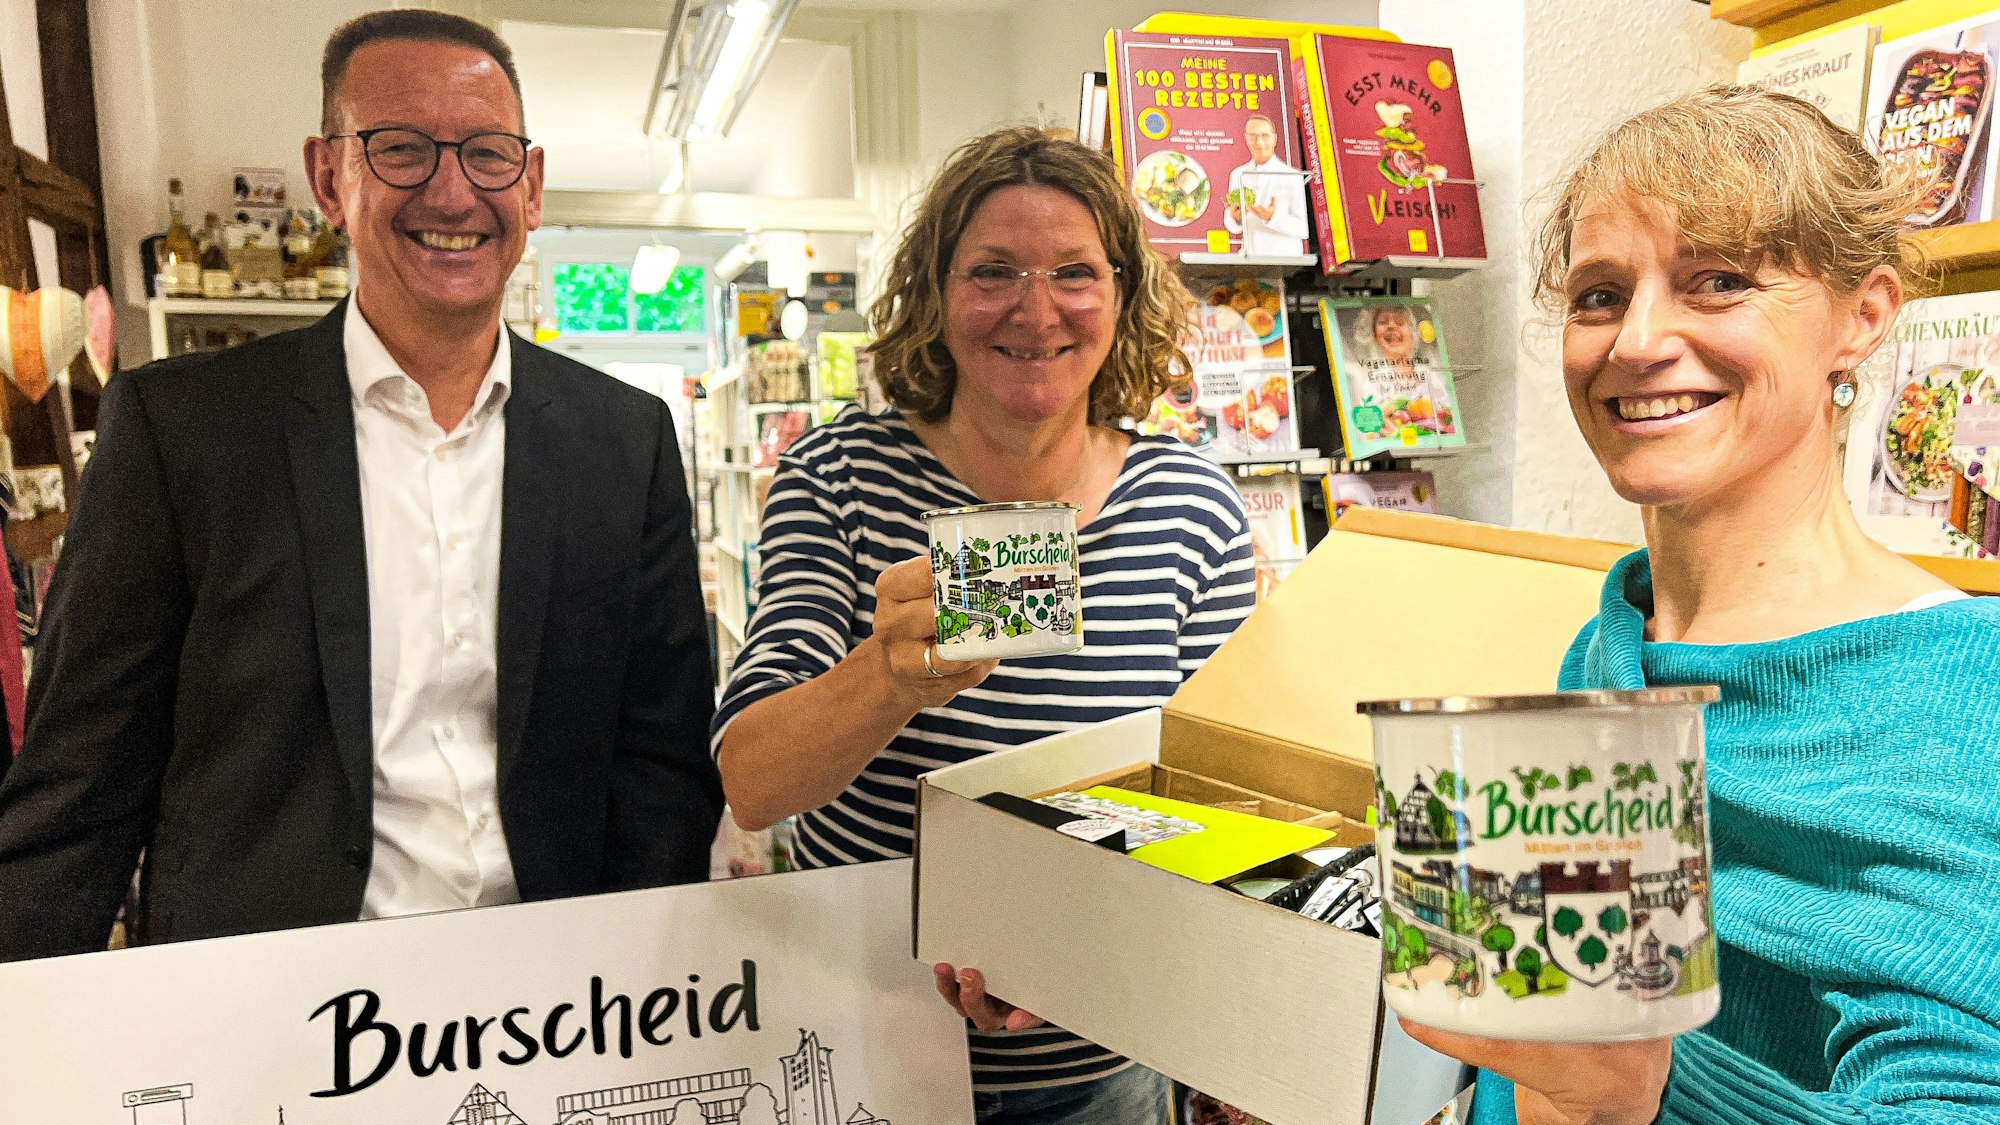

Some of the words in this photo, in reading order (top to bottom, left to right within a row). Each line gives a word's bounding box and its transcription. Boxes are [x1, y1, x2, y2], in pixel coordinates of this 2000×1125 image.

[1181, 57, 1227, 71] MEINE
[1801, 52, 1852, 80] KRAUT
[1134, 69, 1175, 87] 100
[1184, 71, 1275, 92] BESTEN
[1344, 72, 1381, 106] ESST
[1390, 75, 1442, 116] MEHR
[1154, 89, 1260, 110] REZEPTE
[1885, 97, 1956, 130] VEGAN
[1882, 126, 1924, 152] AUS
[1927, 114, 1972, 142] DEM
[1358, 355, 1430, 369] Vegetarische
[1243, 493, 1285, 512] SSUR
[1370, 495, 1407, 509] VEGAN
[993, 540, 1070, 568] Burscheid
[1476, 780, 1673, 839] Burscheid
[307, 958, 761, 1099] Burscheid
